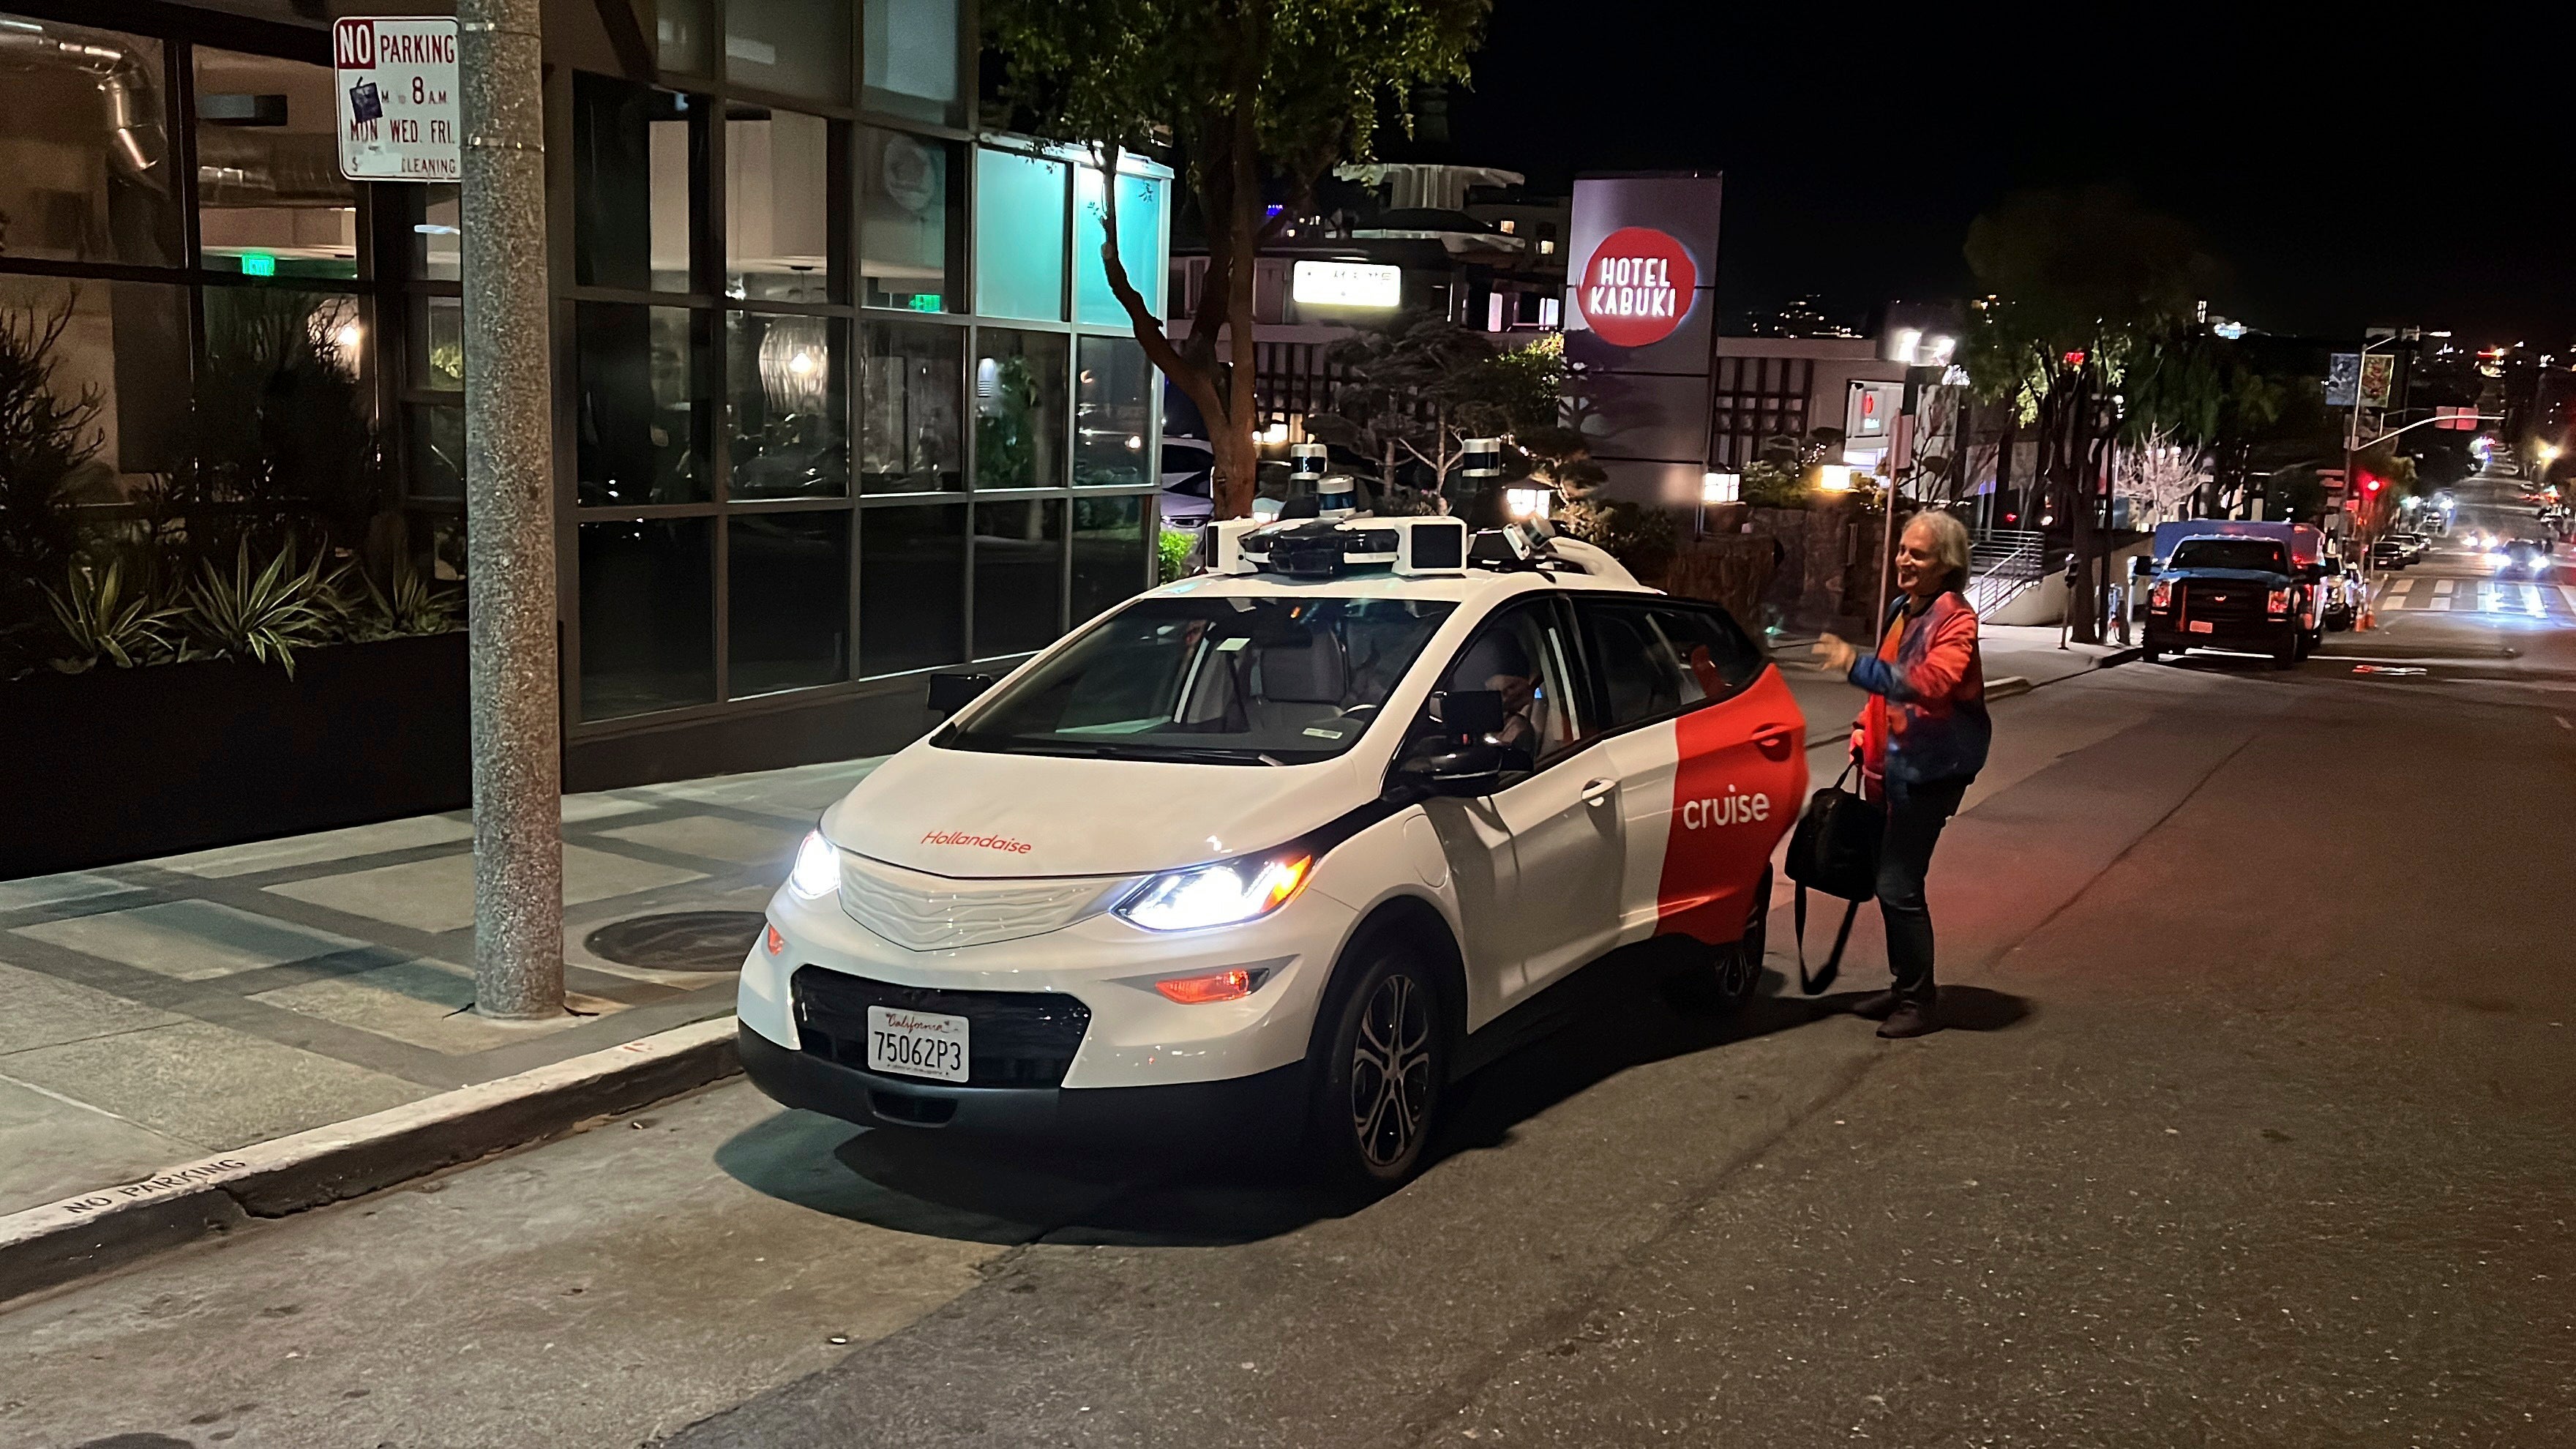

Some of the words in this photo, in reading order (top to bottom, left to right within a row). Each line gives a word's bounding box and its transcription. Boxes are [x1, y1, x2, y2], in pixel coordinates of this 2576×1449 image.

[340, 24, 371, 64] NO
[380, 34, 454, 64] PARKING
[412, 76, 424, 104] 8
[1600, 257, 1670, 286] HOTEL
[1590, 286, 1676, 318] KABUKI
[1683, 784, 1770, 830] cruise
[921, 831, 1031, 854] Hollandaise
[888, 1013, 949, 1034] California
[874, 1031, 961, 1071] 75062P3
[63, 1196, 112, 1213] NO
[117, 1159, 246, 1197] PARKING
